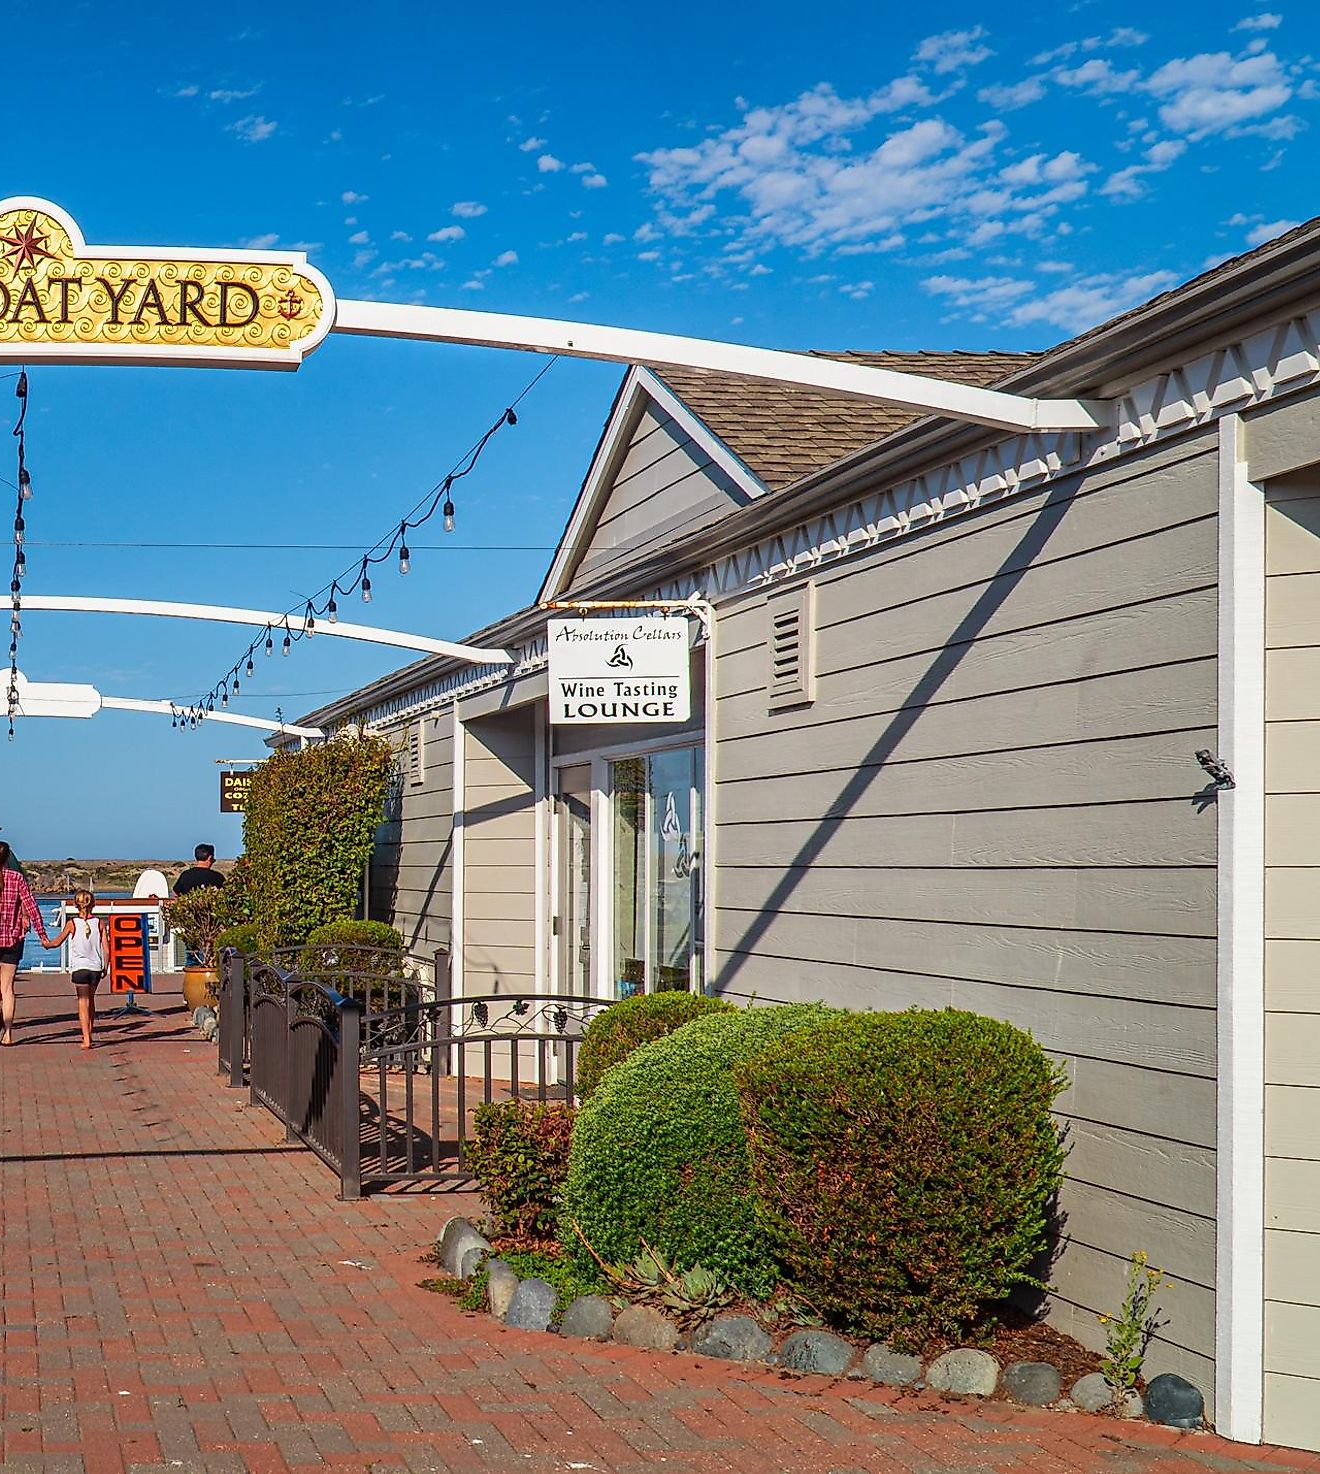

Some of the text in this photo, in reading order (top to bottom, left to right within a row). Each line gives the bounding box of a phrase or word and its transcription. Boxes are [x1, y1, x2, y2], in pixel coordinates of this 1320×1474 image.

[94, 276, 260, 328] YARD
[555, 625, 681, 643] Absolution Cellars
[561, 681, 678, 699] Wine Tasting
[563, 701, 675, 719] LOUNGE
[114, 916, 145, 991] OPEN
